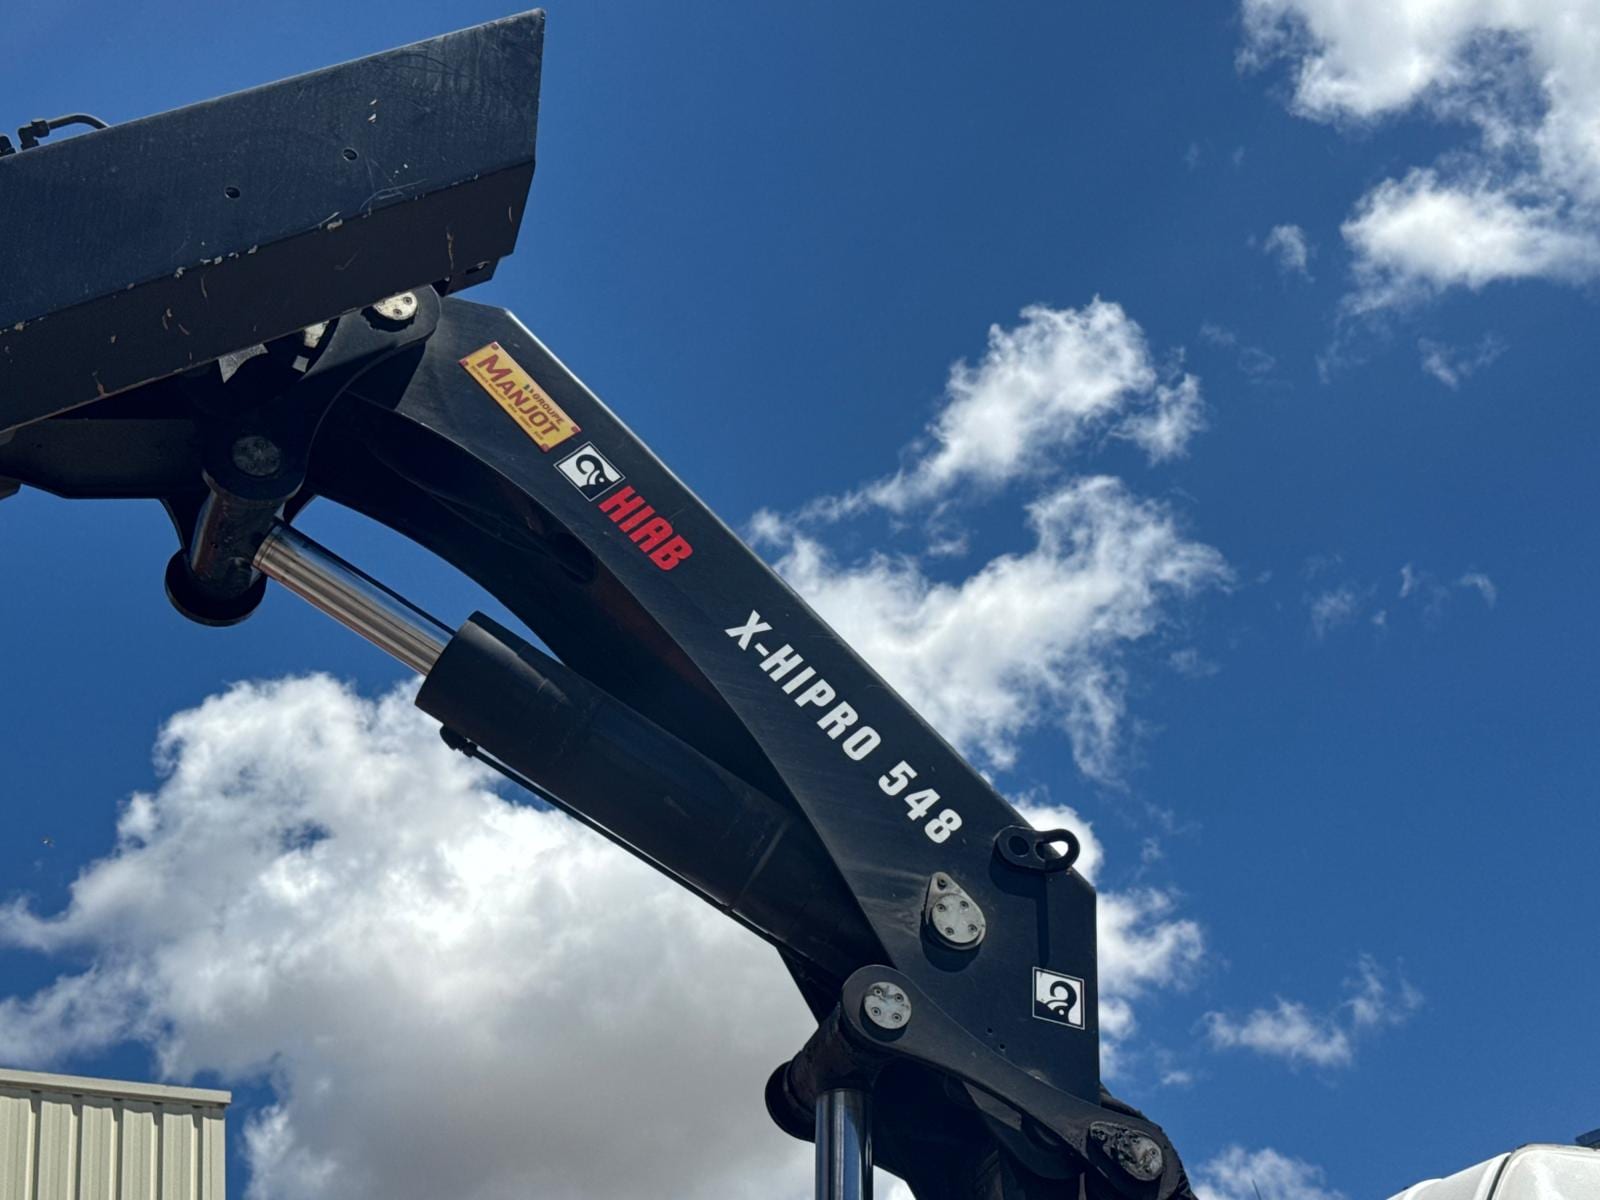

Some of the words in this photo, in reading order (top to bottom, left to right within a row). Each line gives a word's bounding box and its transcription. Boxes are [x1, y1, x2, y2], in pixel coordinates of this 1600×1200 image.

[476, 354, 560, 435] MANJOT
[532, 393, 566, 425] GROUPE
[598, 485, 693, 571] HIAB
[724, 609, 882, 761] X-HIPRO
[878, 760, 963, 844] 548
